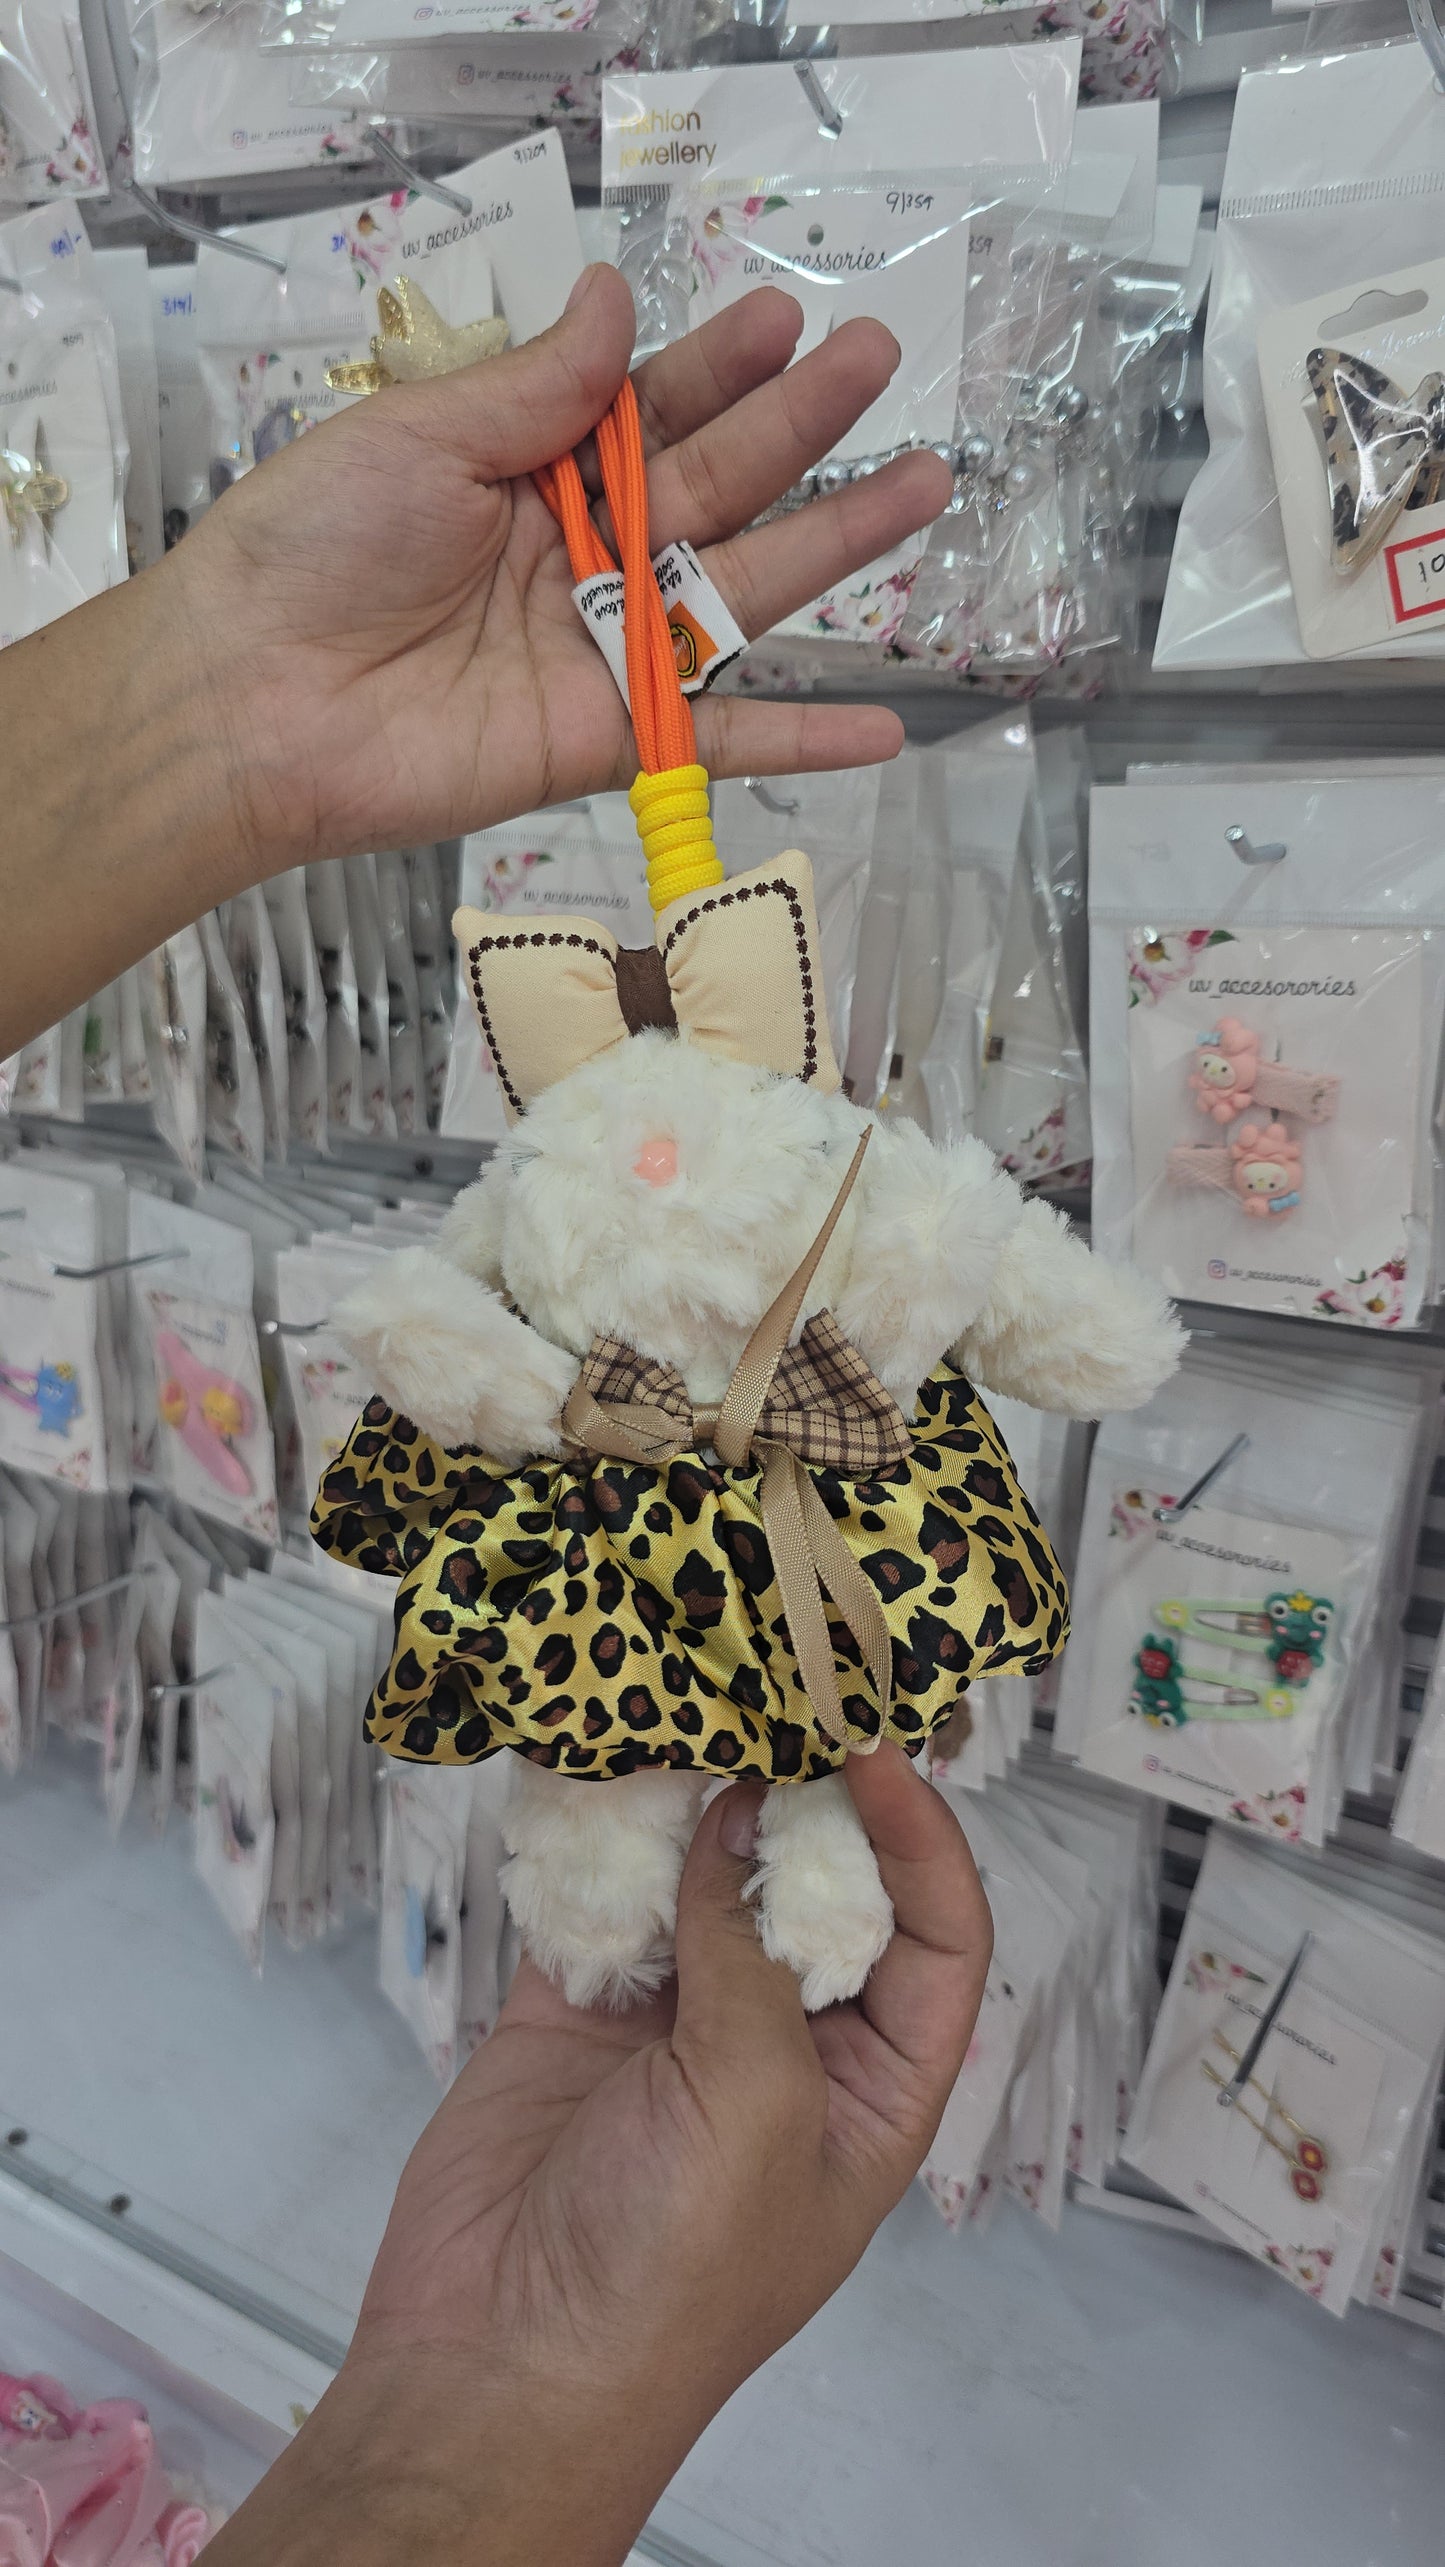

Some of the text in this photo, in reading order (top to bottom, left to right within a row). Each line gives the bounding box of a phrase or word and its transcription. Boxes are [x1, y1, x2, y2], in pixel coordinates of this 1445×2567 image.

[620, 106, 702, 135] fashion
[619, 141, 717, 171] jewellery
[402, 200, 514, 259] uv_accessories
[1188, 976, 1356, 998] uv_accesorories
